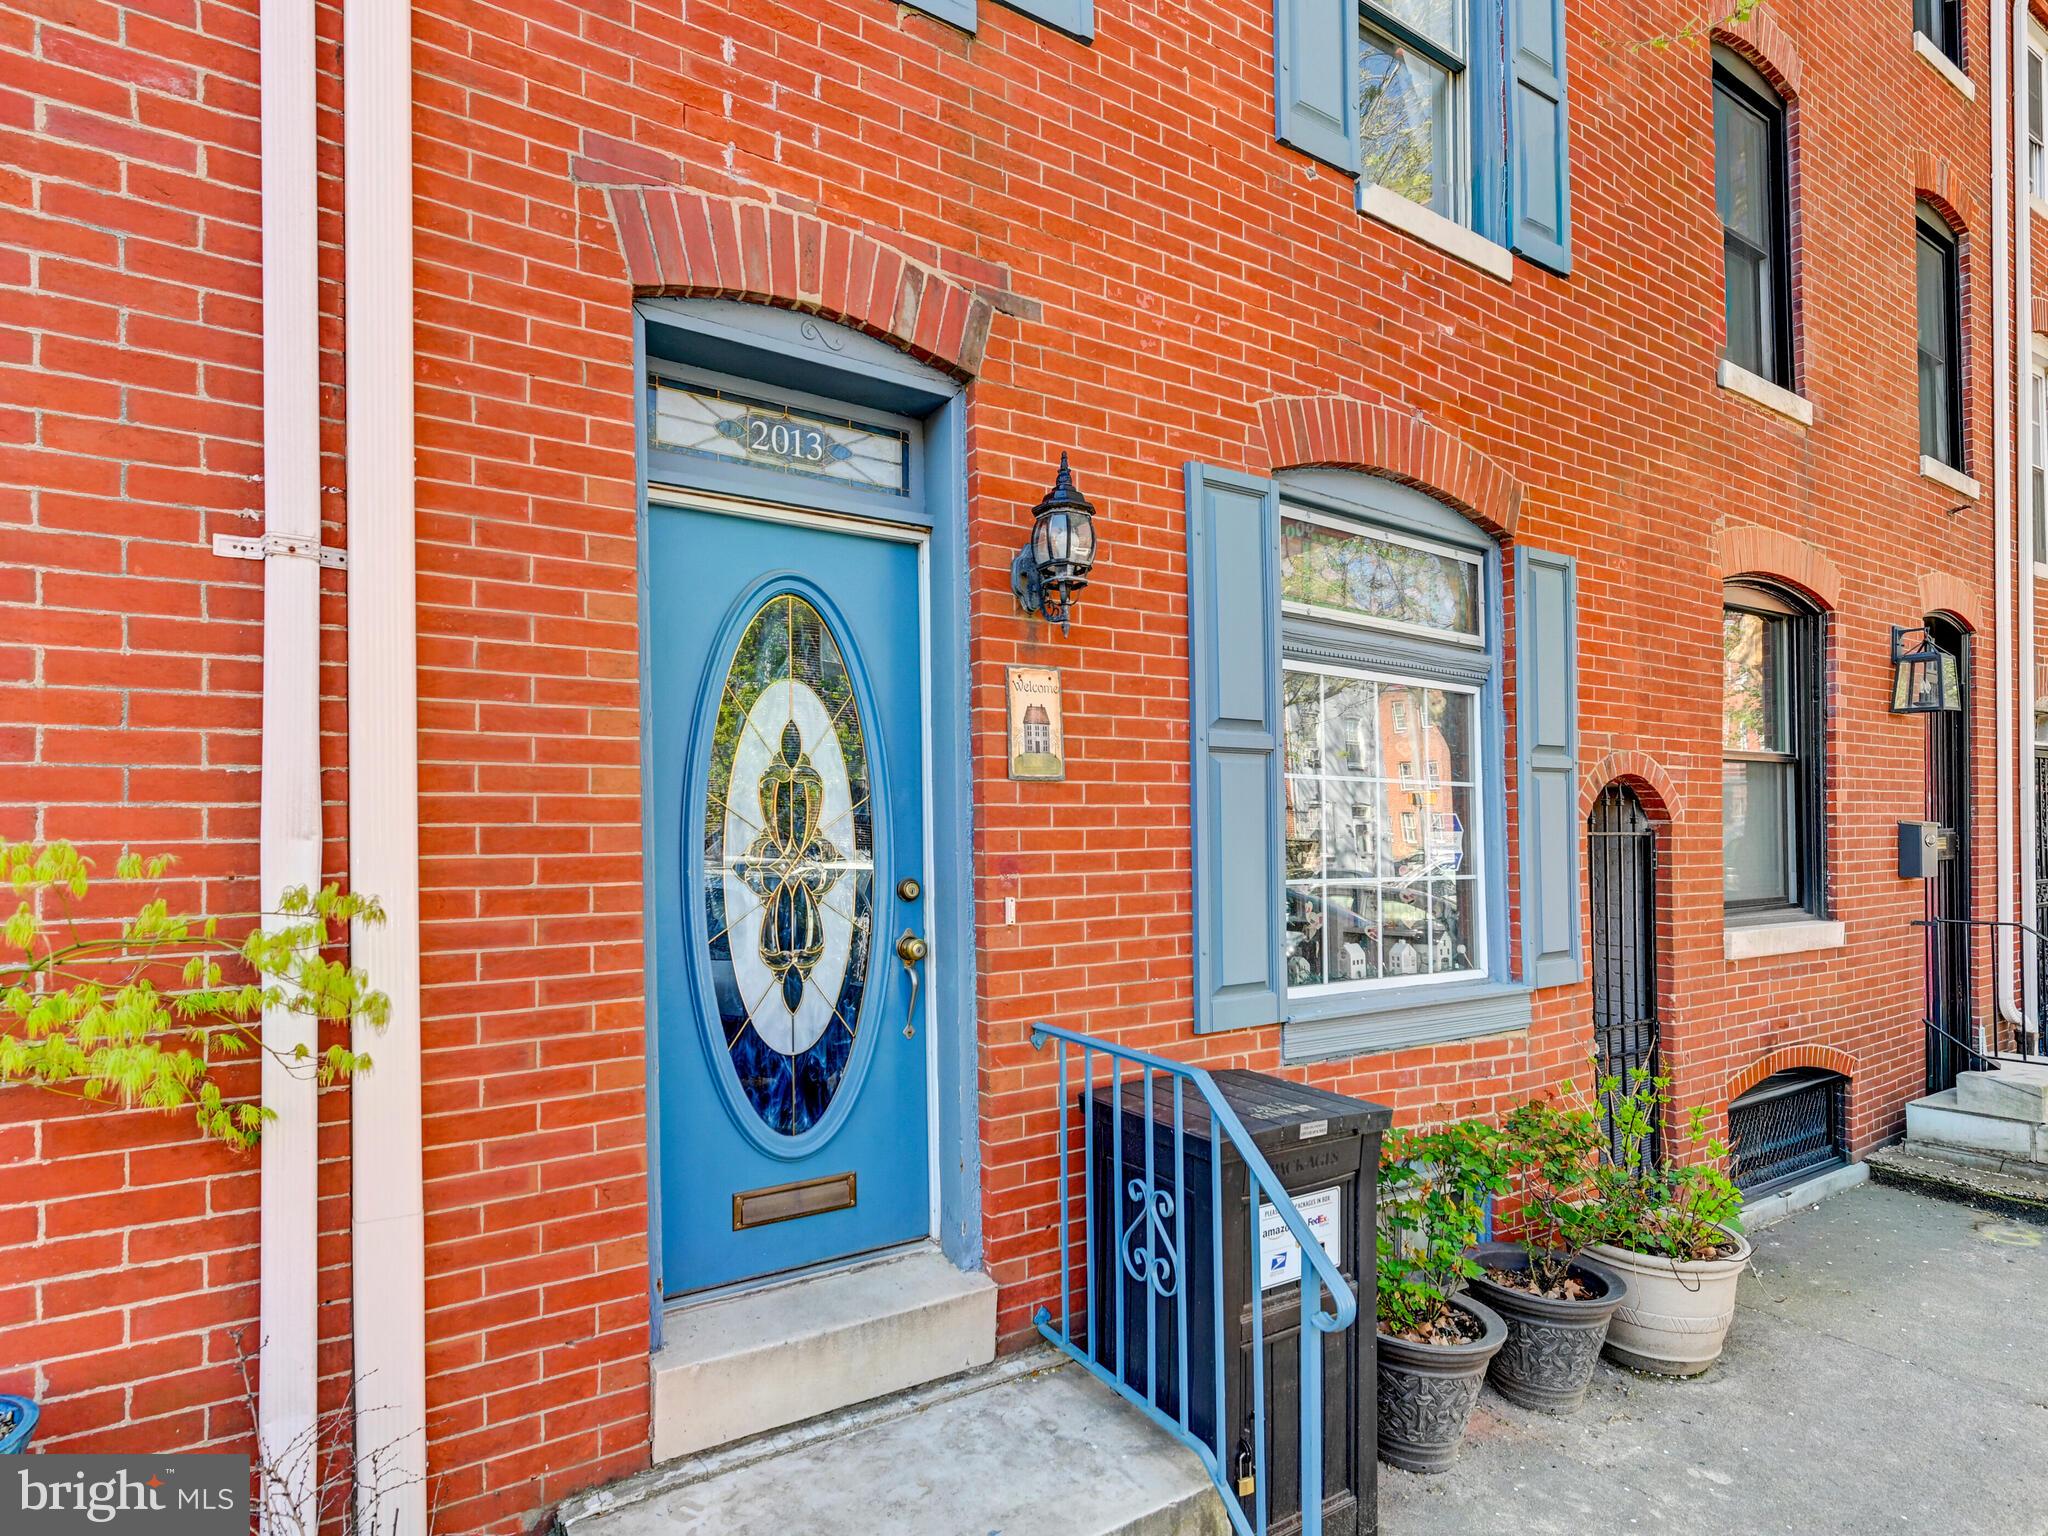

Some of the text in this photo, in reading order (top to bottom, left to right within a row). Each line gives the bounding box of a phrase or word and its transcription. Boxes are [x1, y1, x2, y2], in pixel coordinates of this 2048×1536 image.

[751, 420, 823, 461] 2013
[1012, 678, 1059, 694] Welcome
[1264, 1208, 1279, 1218] PLEAS
[1262, 1214, 1328, 1239] amazo FedEx
